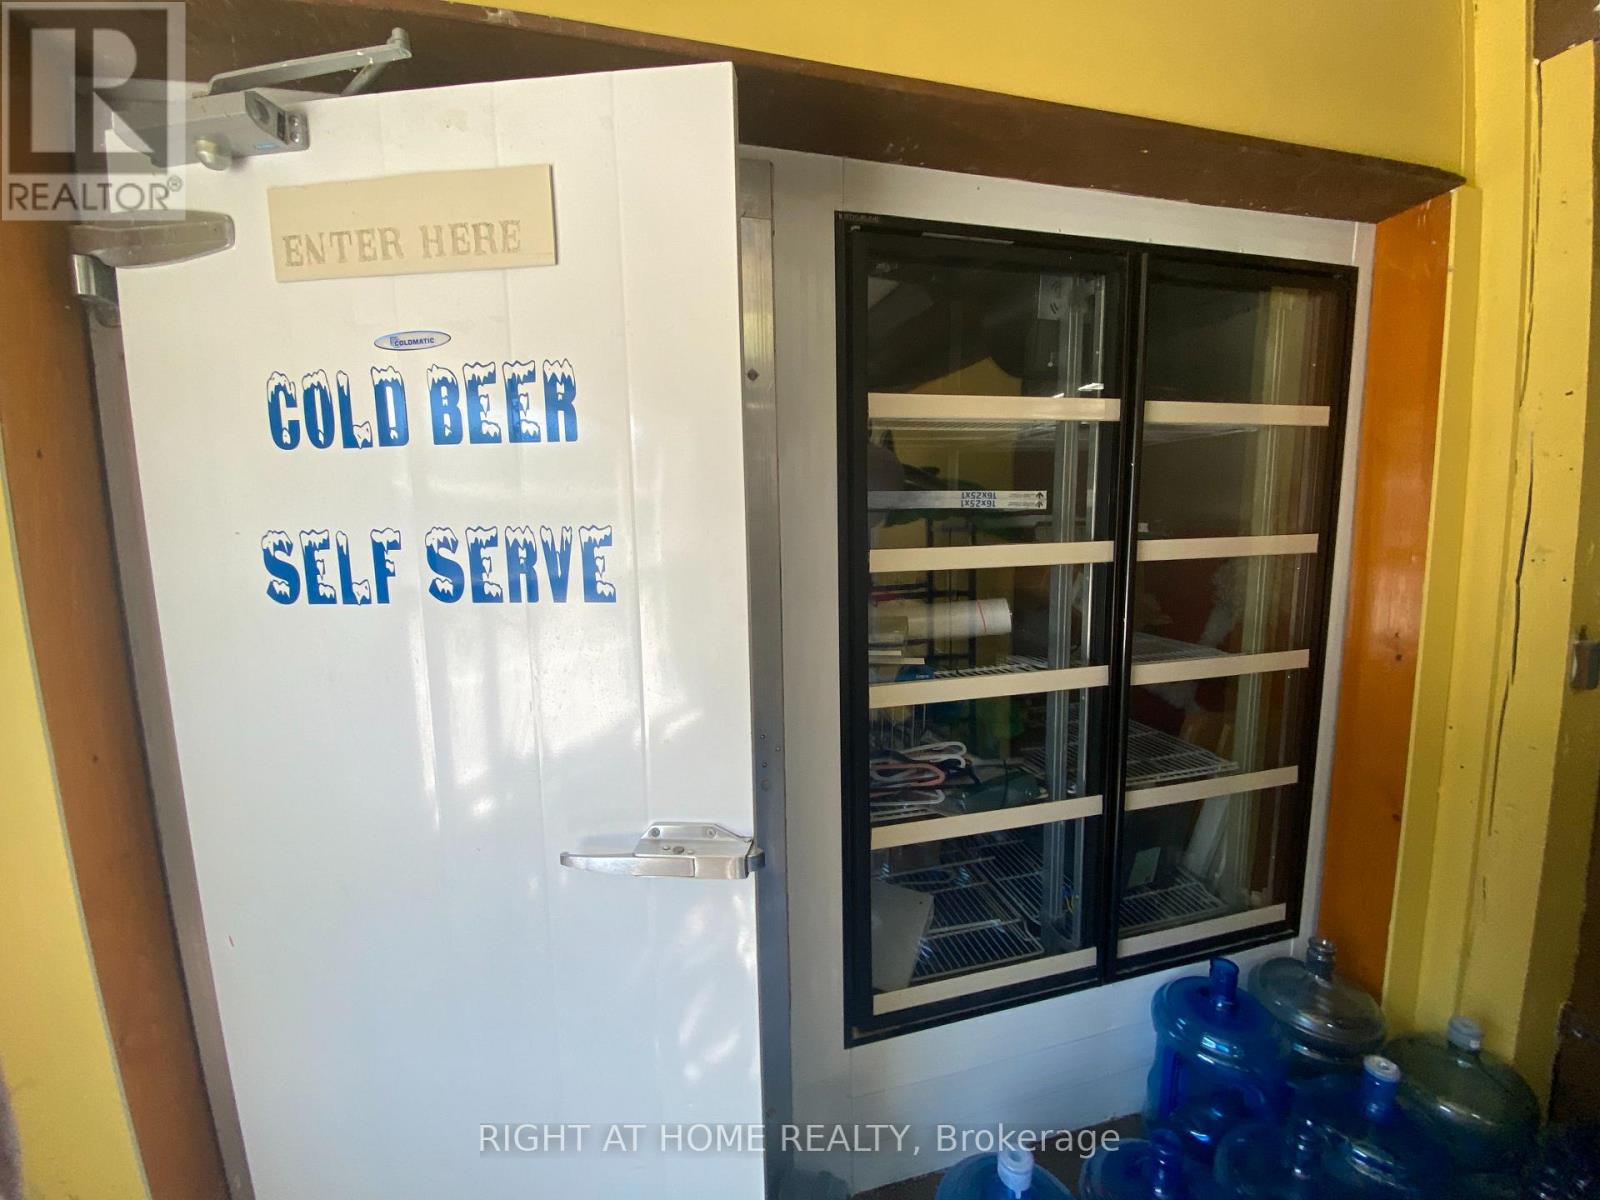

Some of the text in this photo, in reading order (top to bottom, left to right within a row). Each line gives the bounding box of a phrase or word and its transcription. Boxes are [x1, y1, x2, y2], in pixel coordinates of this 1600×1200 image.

[282, 220, 522, 267] ENTER HERE
[394, 337, 435, 347] COLDMATIC
[266, 358, 578, 450] COLD BEER
[261, 525, 617, 605] SELF SERVE
